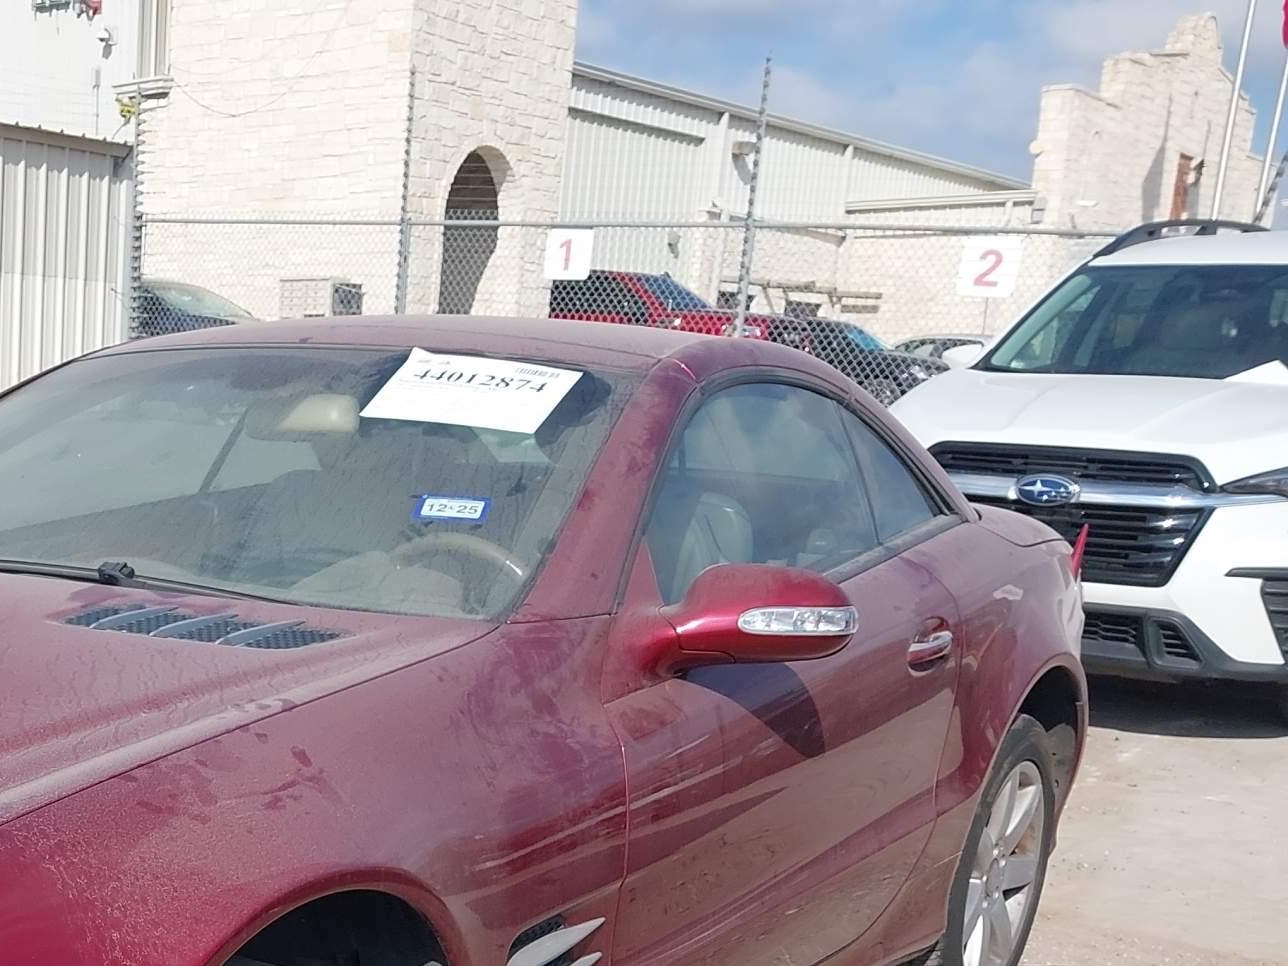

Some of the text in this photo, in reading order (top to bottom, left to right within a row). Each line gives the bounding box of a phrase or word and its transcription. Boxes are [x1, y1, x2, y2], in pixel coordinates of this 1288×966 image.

[559, 239, 573, 272] 1
[974, 249, 1004, 287] 2
[414, 369, 548, 393] 44012874
